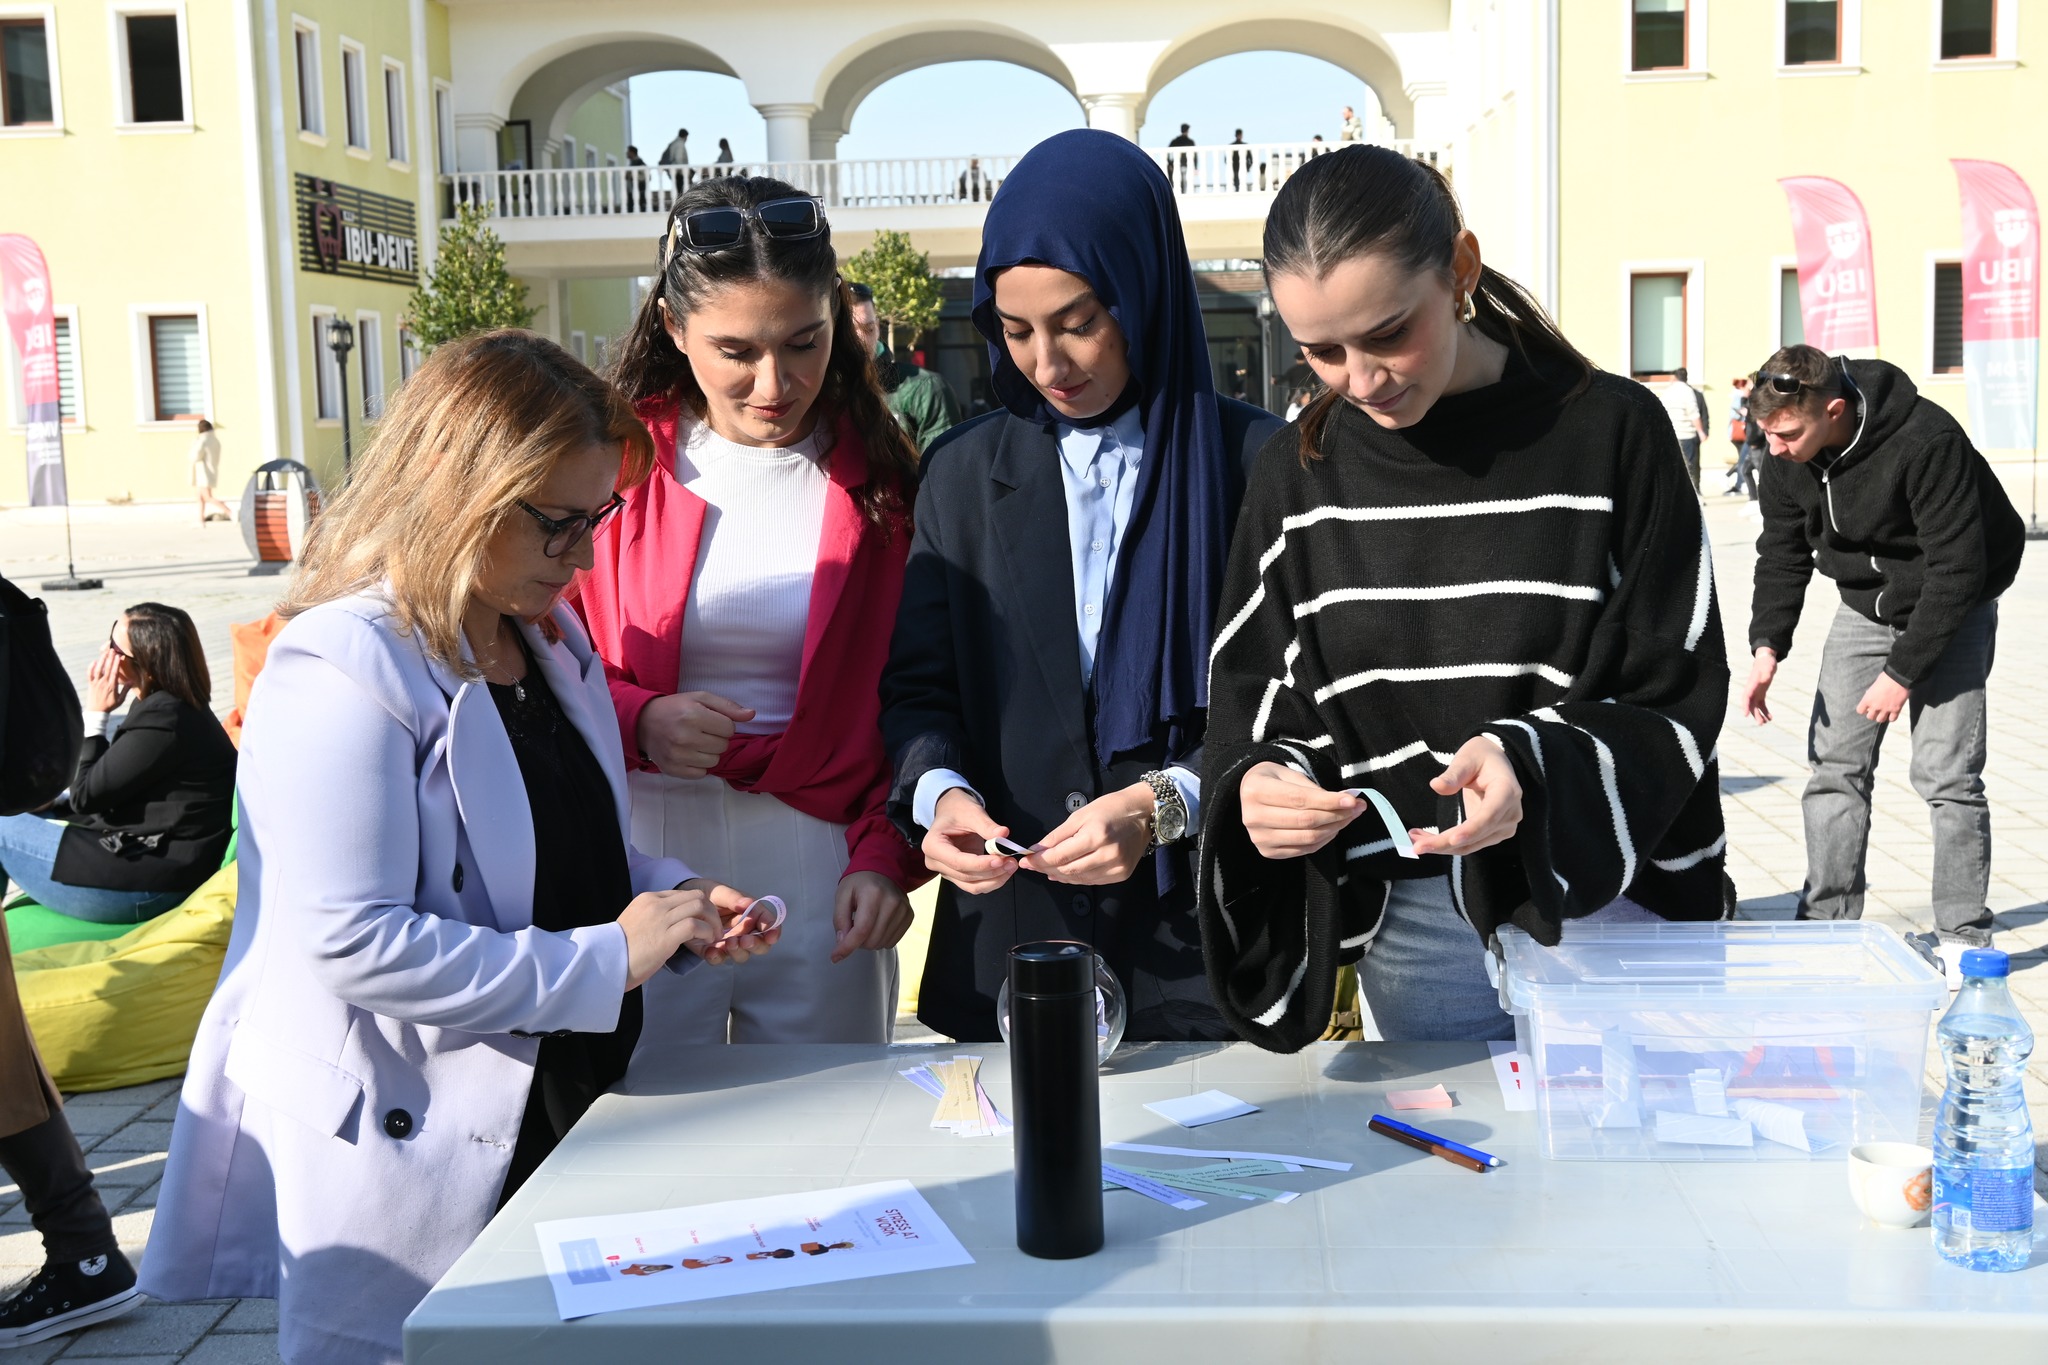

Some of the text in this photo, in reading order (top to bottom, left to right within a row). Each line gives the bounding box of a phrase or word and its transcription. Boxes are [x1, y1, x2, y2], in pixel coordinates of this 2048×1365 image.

[345, 226, 413, 271] IBU-DENT
[875, 1216, 898, 1236] WORK
[885, 1208, 911, 1231] STRESS
